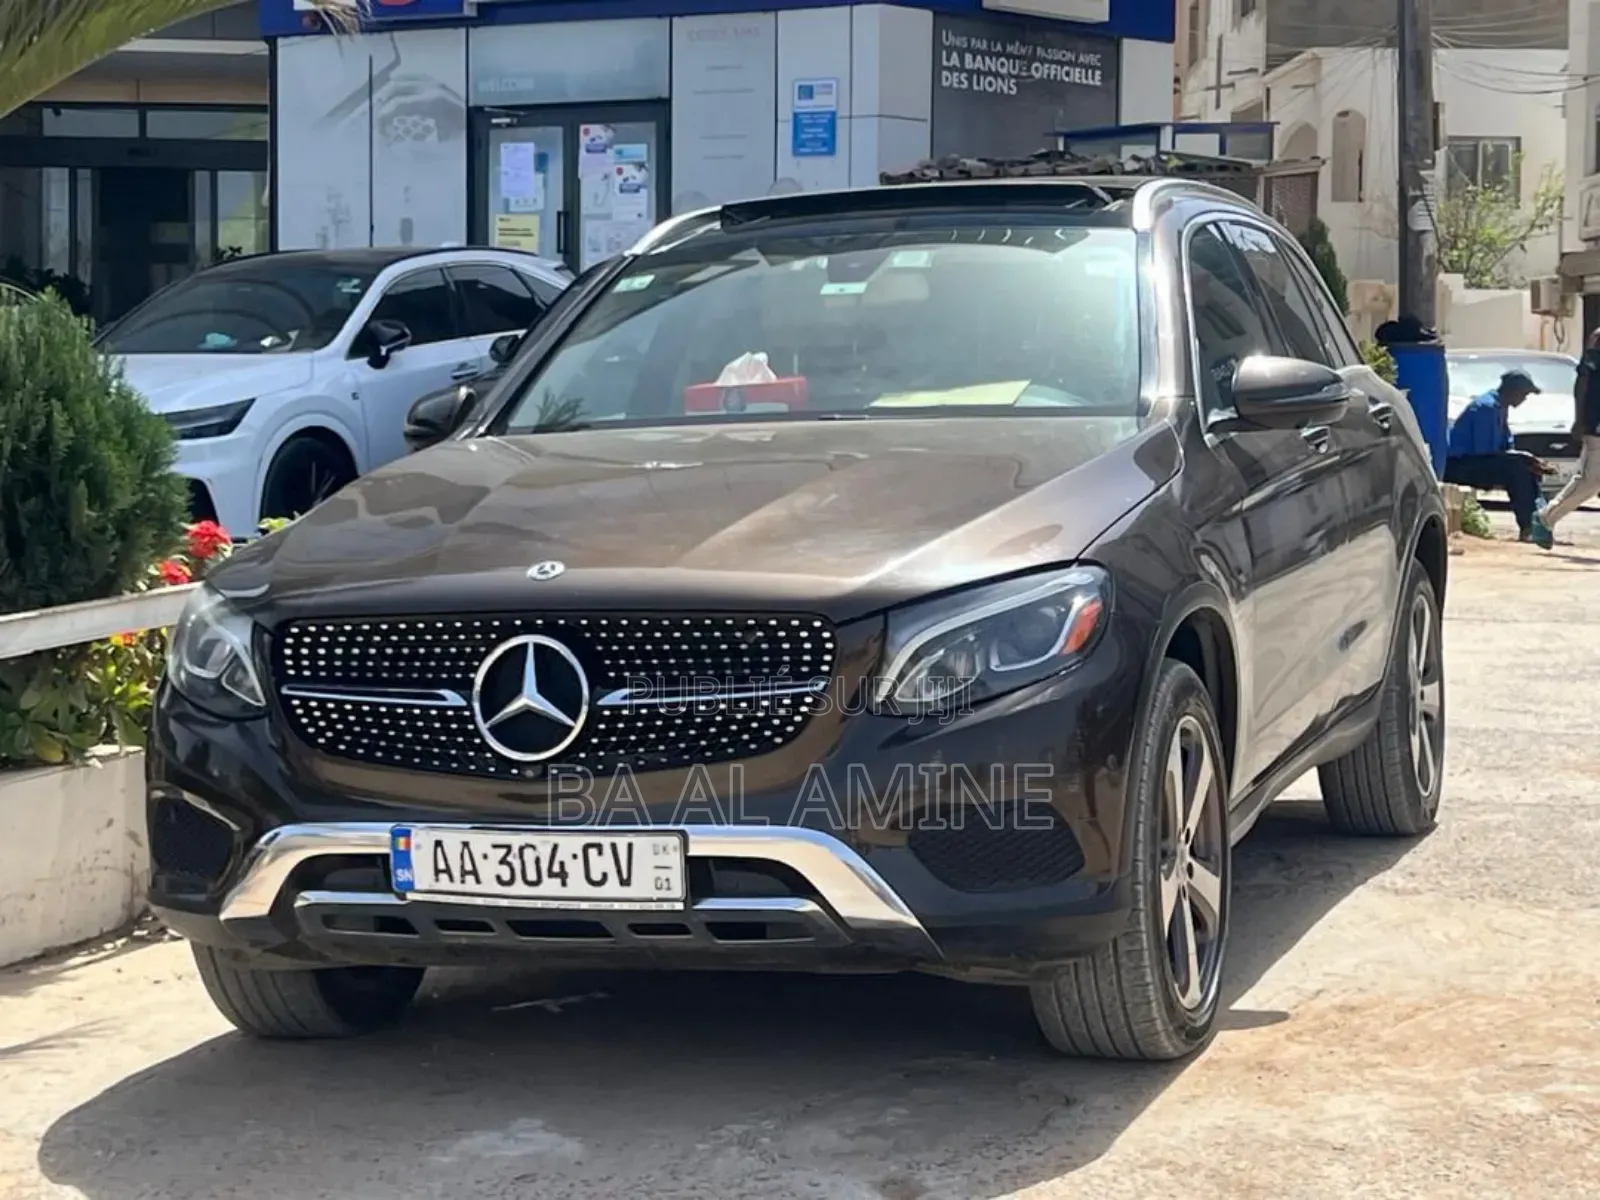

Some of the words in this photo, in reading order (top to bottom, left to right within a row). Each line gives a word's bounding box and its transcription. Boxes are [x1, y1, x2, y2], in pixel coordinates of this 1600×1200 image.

[941, 50, 960, 68] LA
[964, 52, 1028, 76] BANQUE
[1031, 61, 1102, 86] OFFICIELLE
[941, 70, 968, 89] DES
[974, 74, 1017, 96] LIONS
[396, 868, 413, 882] SN
